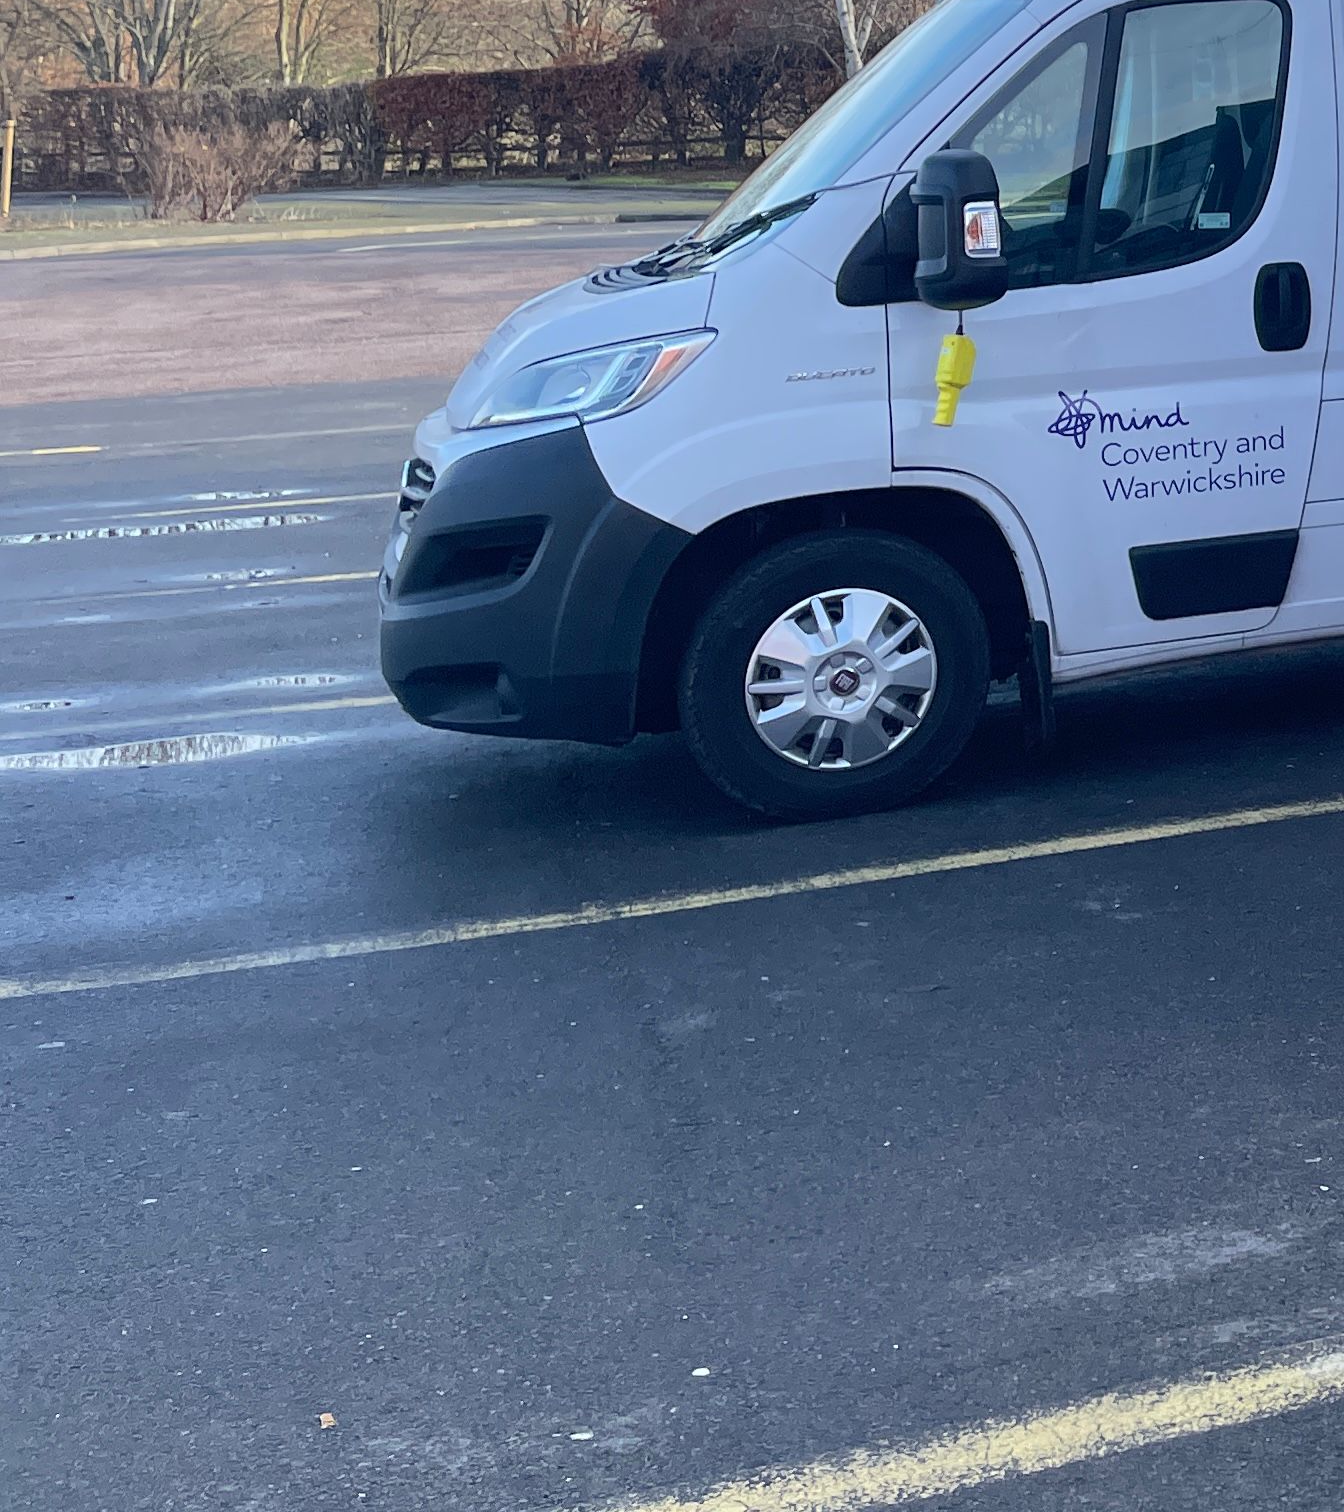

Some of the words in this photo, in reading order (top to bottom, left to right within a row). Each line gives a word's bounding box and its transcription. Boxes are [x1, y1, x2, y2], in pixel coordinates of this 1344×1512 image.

[1098, 402, 1190, 434] mind
[1101, 437, 1228, 467] Coventry
[1236, 425, 1285, 454] and
[1102, 463, 1286, 502] Warwickshire
